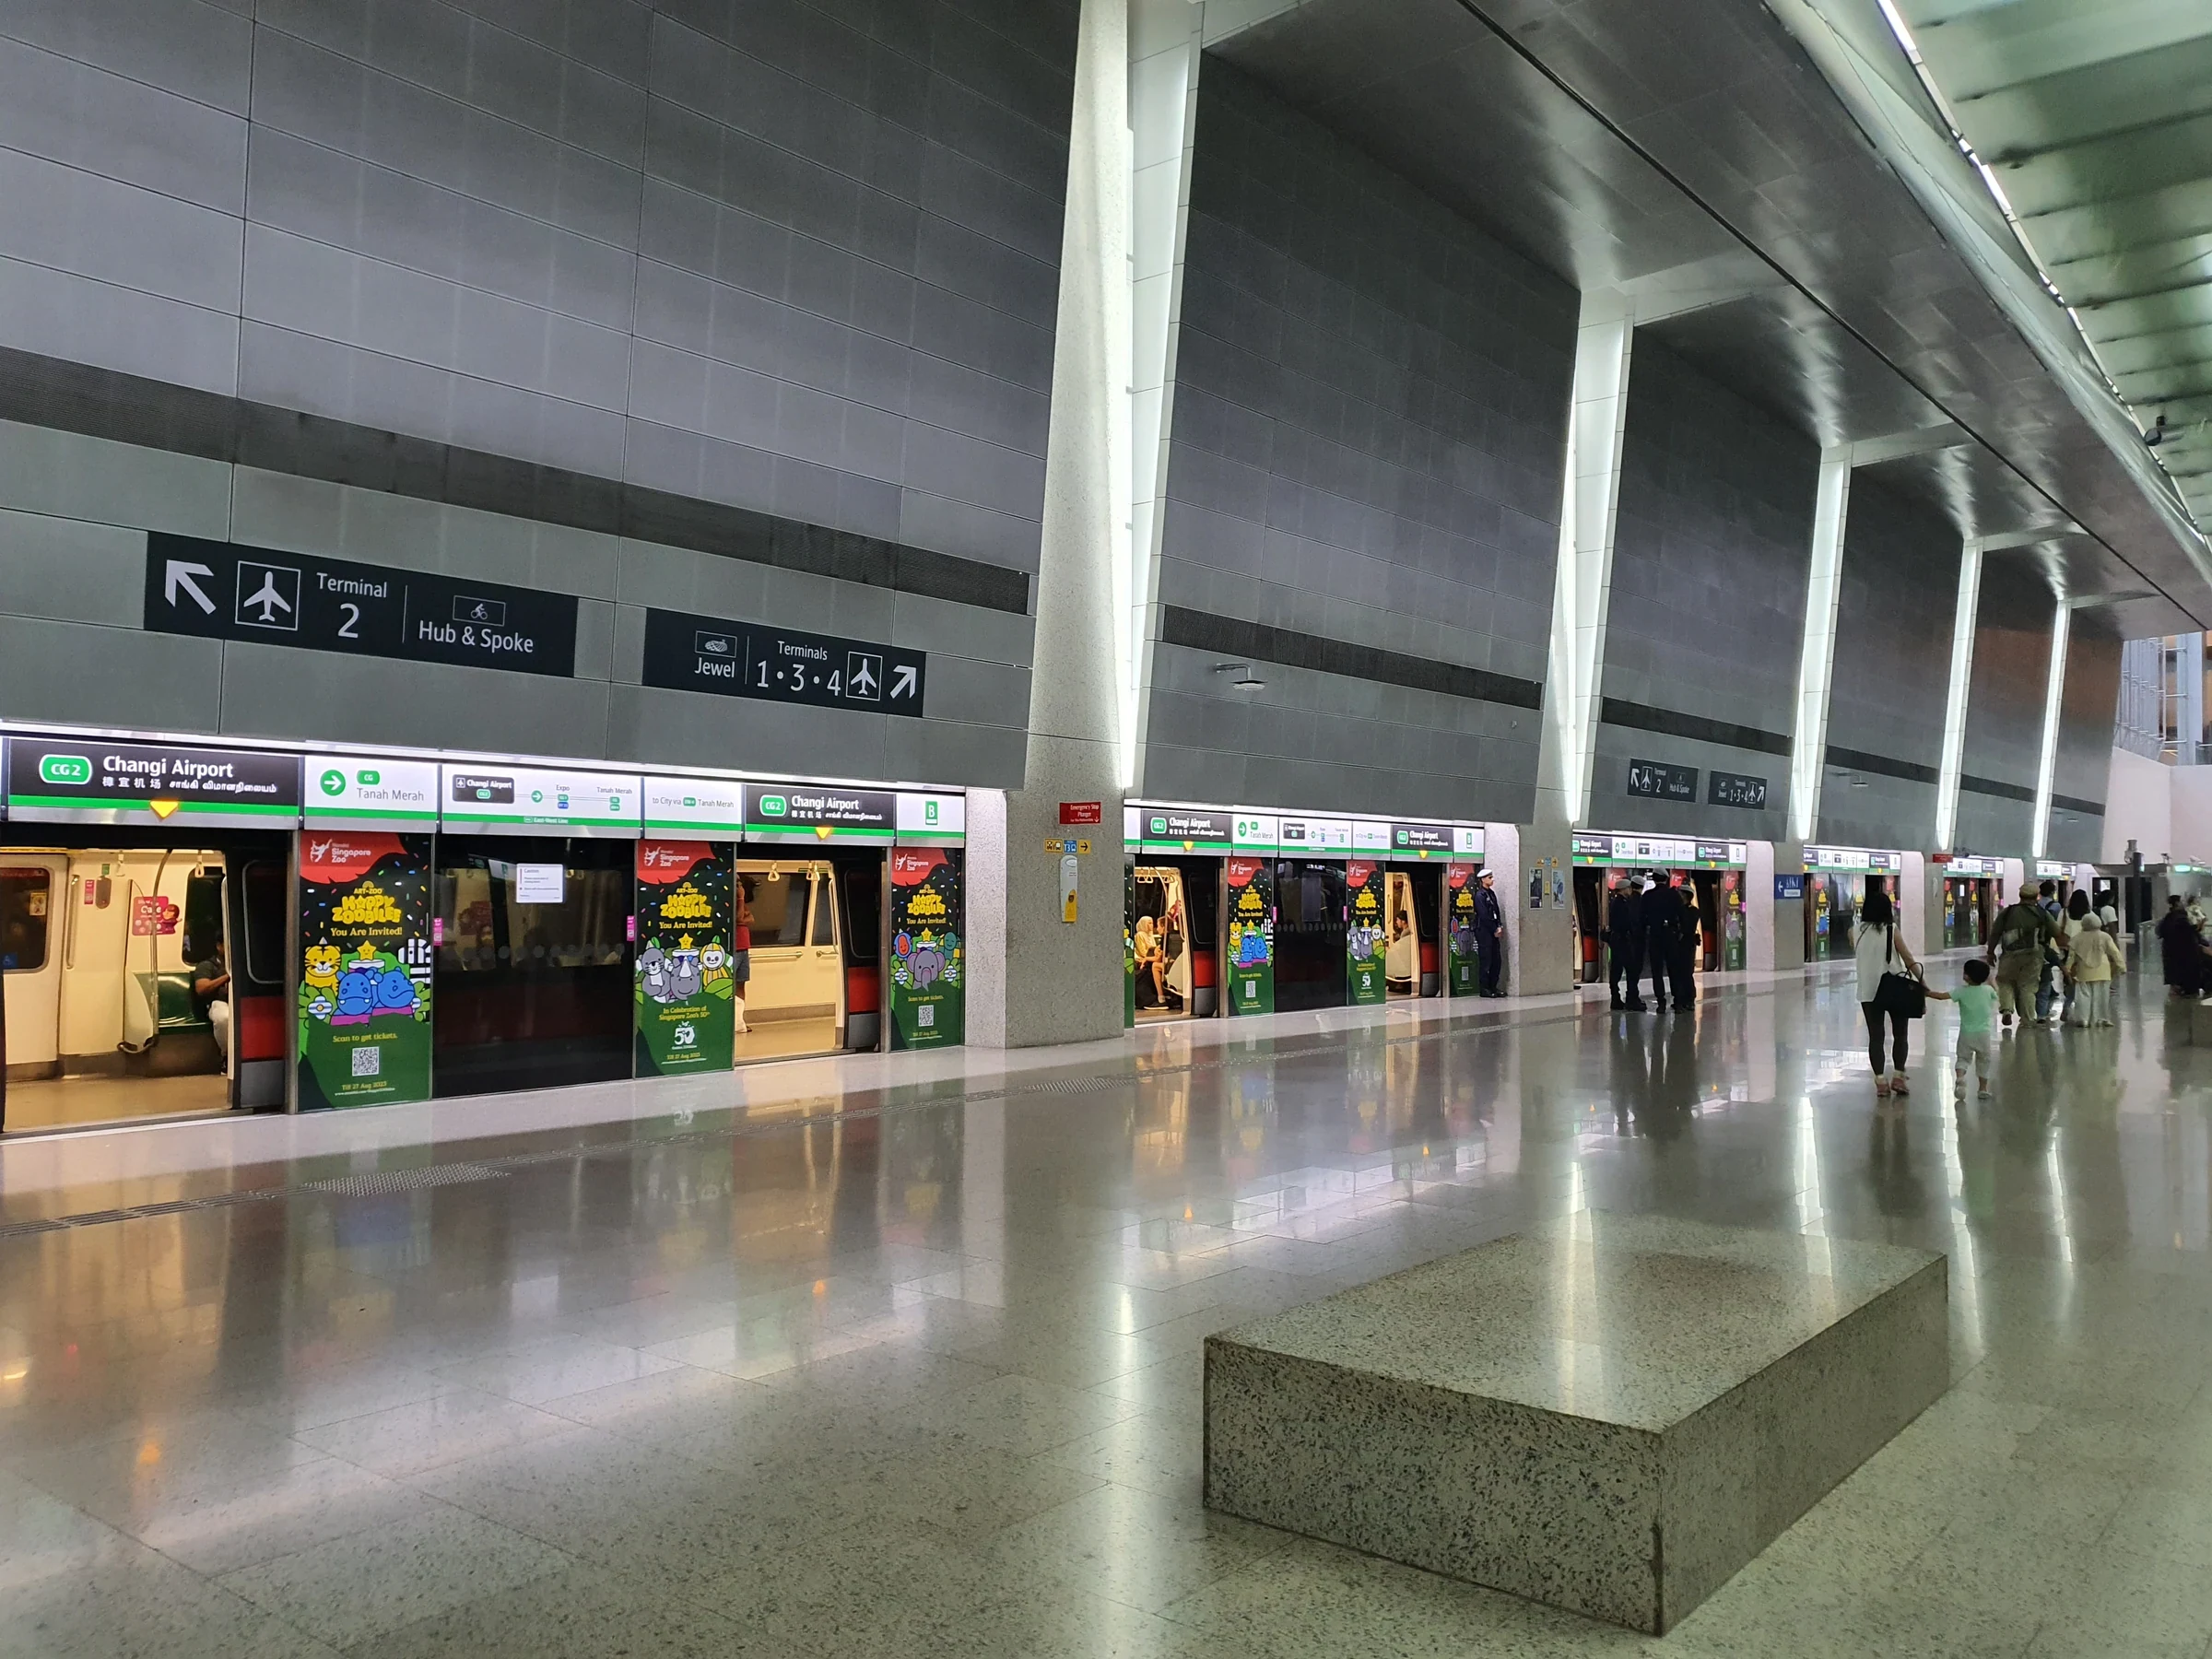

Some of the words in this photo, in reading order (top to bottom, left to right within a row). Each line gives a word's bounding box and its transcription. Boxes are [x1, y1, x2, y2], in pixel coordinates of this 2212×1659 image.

[317, 572, 387, 598] Terminal
[337, 604, 359, 639] 2
[418, 620, 456, 642] Hub
[461, 627, 476, 645] &
[480, 629, 534, 653] Spoke
[777, 641, 828, 661] Terminals
[694, 657, 735, 678] Jewel
[51, 763, 81, 777] CG2
[103, 756, 167, 776] Changi
[171, 759, 234, 780] Airport
[363, 773, 374, 782] CG
[466, 779, 489, 789] Changi
[490, 781, 512, 790] Airport
[556, 784, 571, 793] Expo
[596, 786, 614, 794] Tanah
[1655, 779, 1662, 793] 2
[357, 787, 389, 800] Tanah
[392, 789, 424, 802] Merah
[660, 797, 672, 807] City
[697, 799, 716, 807] Tanah
[716, 800, 735, 808] Merah
[765, 801, 782, 811] CG2
[791, 795, 825, 810] Changi
[827, 796, 859, 811] Airport
[928, 805, 935, 818] B
[1169, 817, 1190, 829] Changi
[1190, 818, 1211, 830] Airport
[332, 848, 371, 858] Singapore
[660, 853, 689, 862] Singapore
[332, 907, 402, 924] ZOOBILEE
[660, 903, 712, 919] ZOOBILEE
[330, 927, 347, 936] You
[349, 927, 367, 936] Are
[369, 926, 403, 935] Invited!
[360, 1034, 372, 1042] get
[674, 1026, 695, 1045] 50
